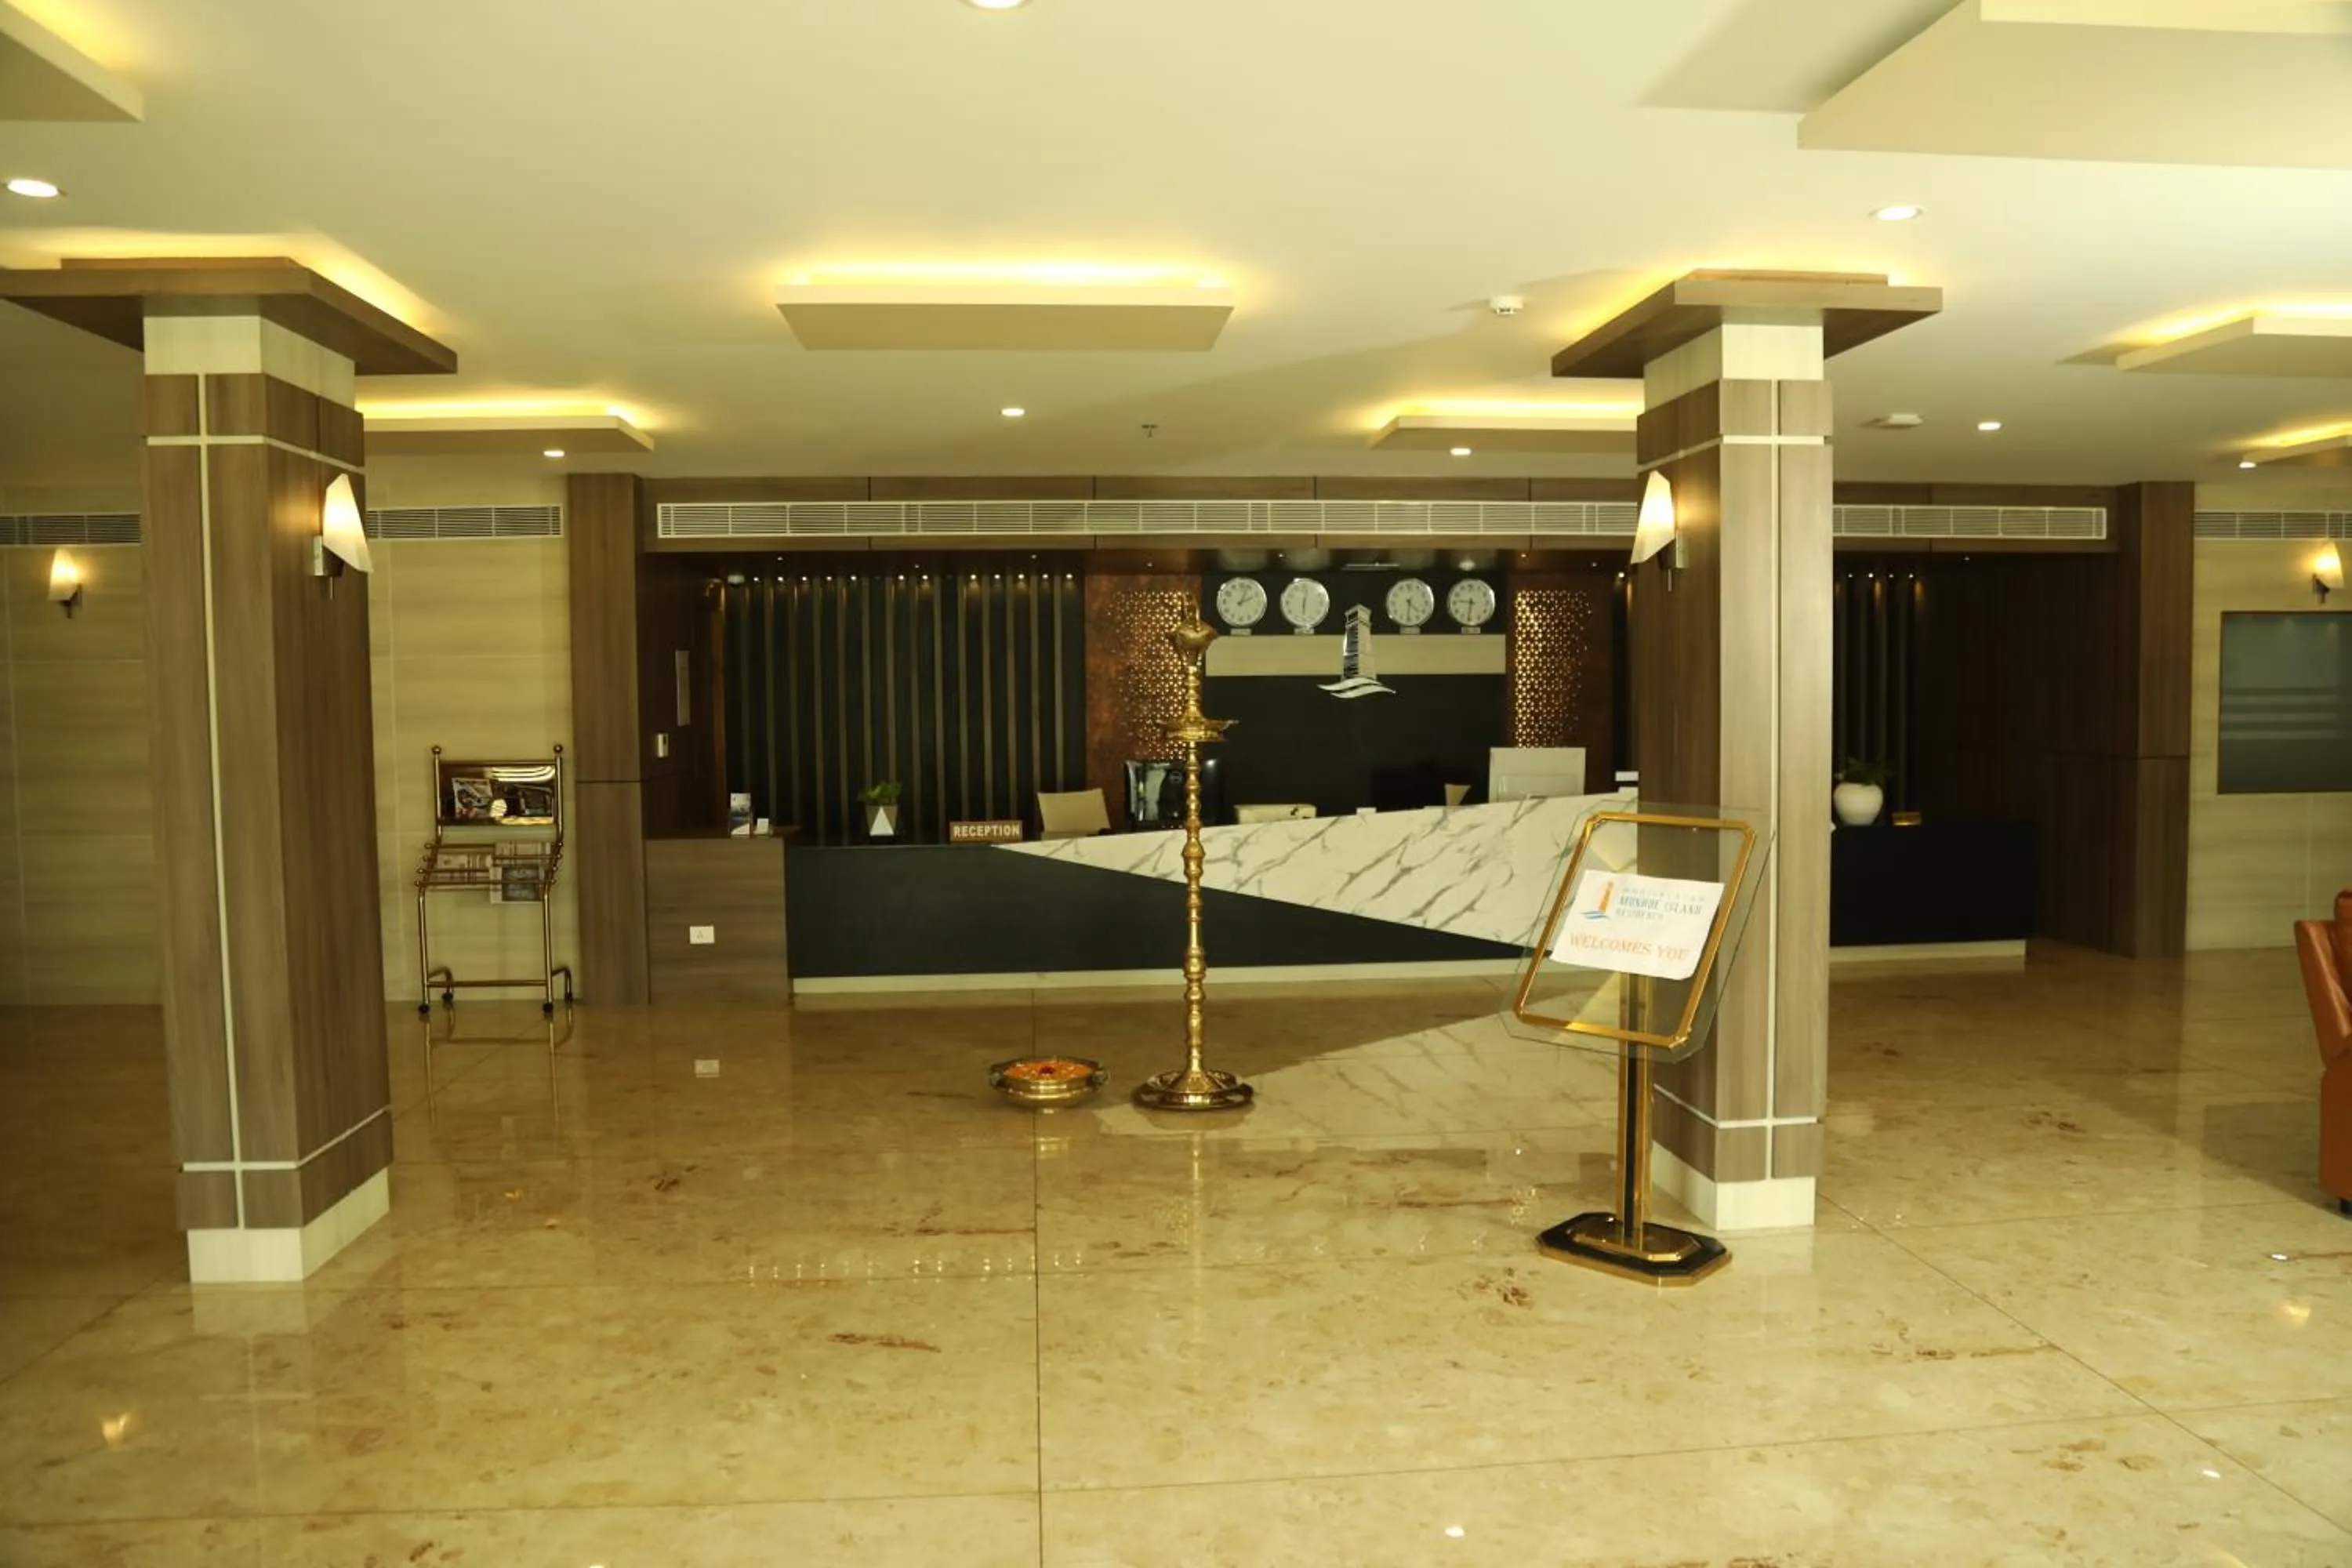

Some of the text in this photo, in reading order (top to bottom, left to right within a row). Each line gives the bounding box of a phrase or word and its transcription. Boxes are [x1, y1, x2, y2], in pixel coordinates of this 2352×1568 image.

[952, 824, 1020, 838] RECEPTION
[1569, 932, 1691, 962] WELCOMES YOU
